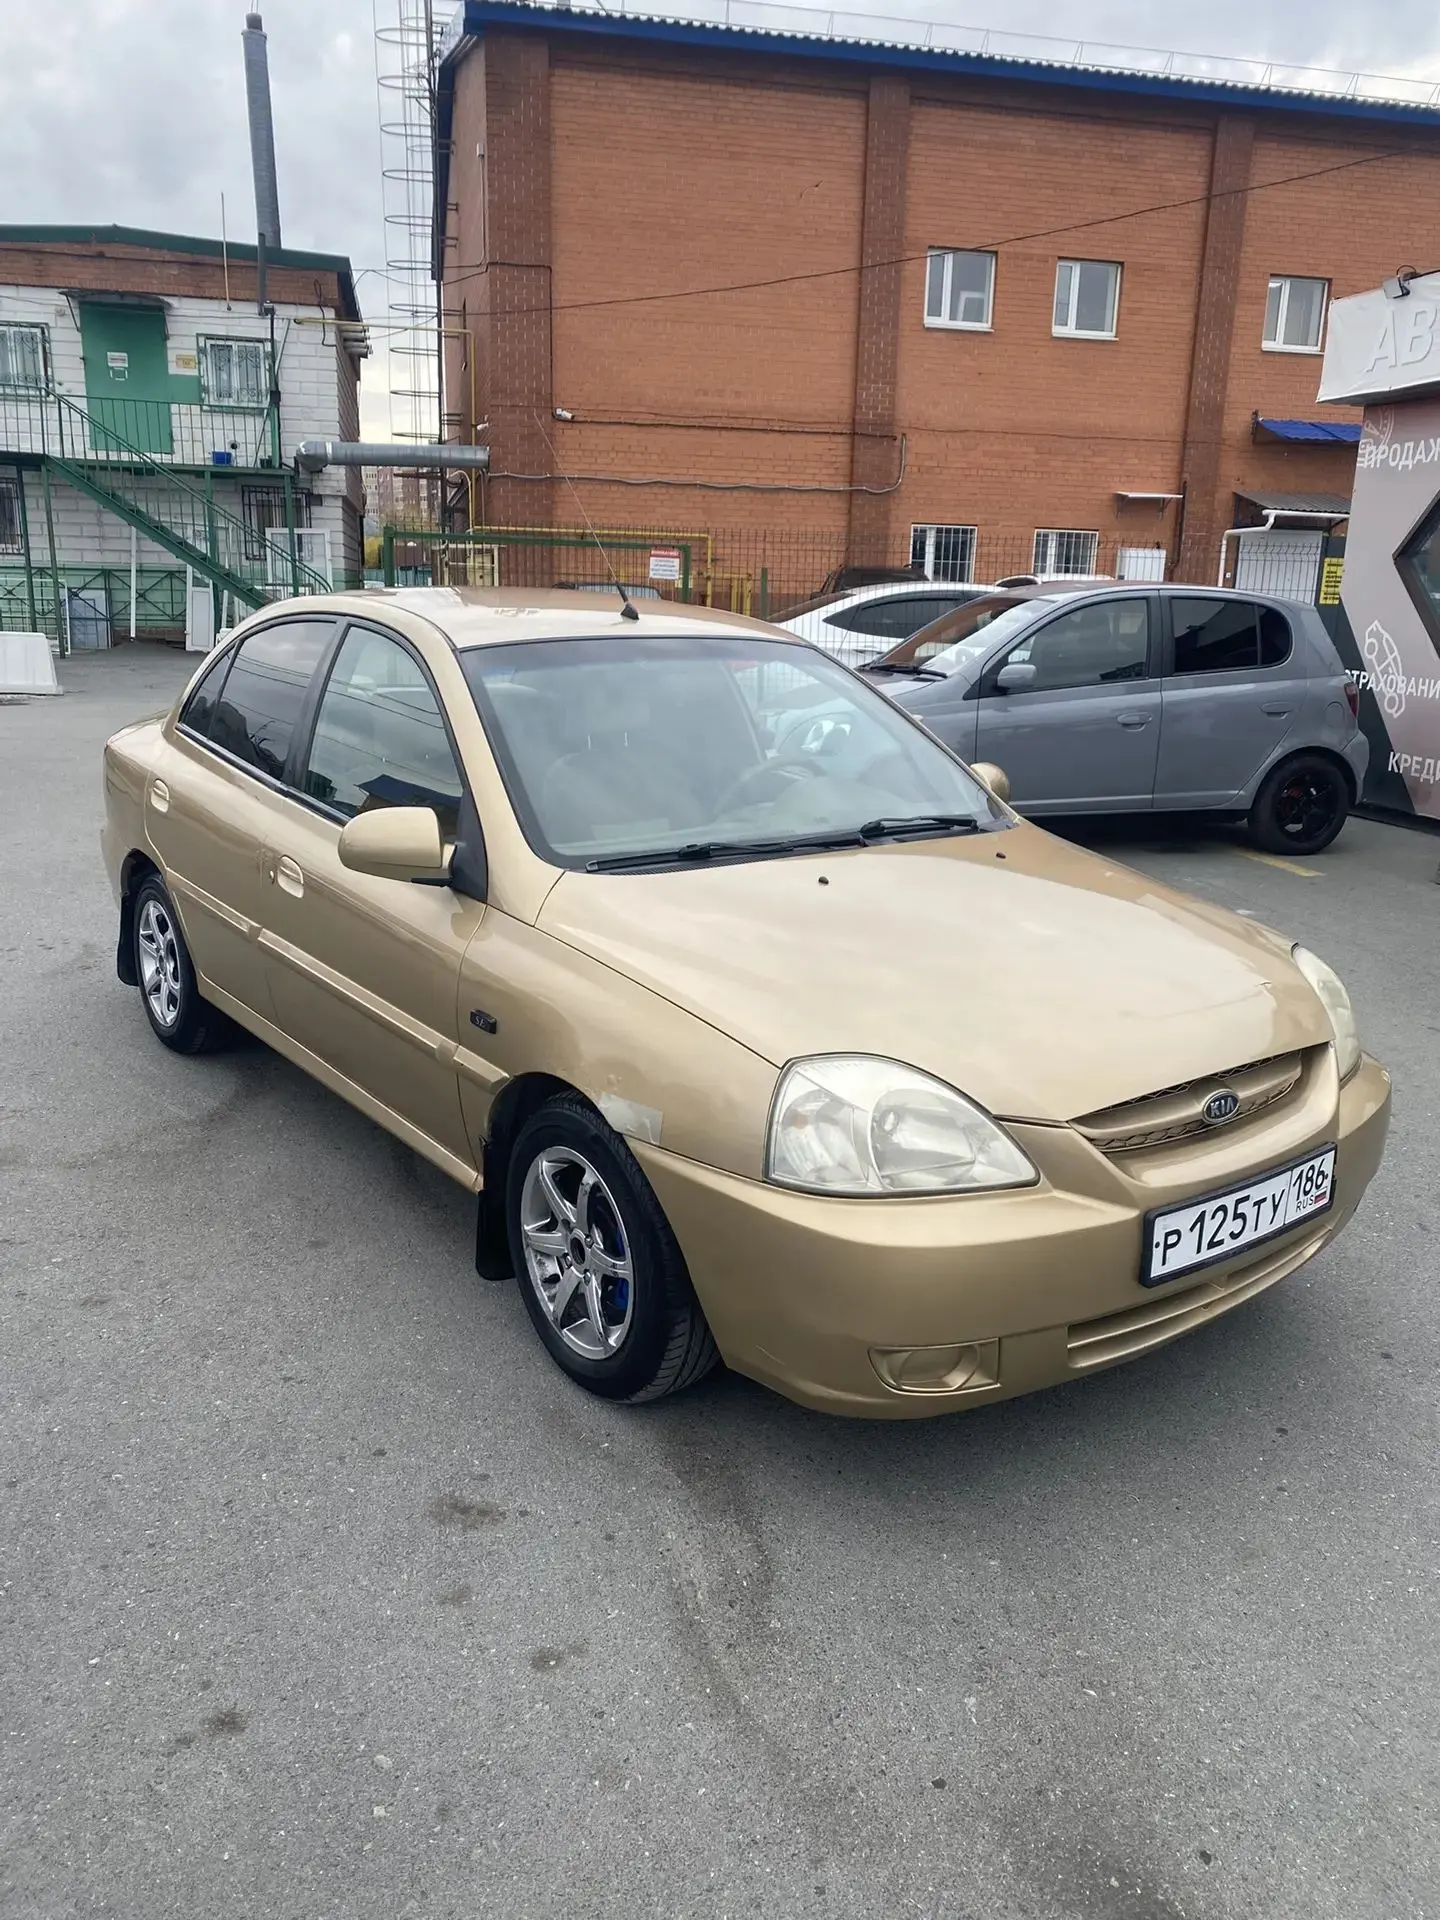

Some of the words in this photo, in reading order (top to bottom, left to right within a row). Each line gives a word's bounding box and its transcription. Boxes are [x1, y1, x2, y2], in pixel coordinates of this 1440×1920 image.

[1210, 1097, 1234, 1117] KIA
[1292, 1158, 1326, 1201] 186
[1295, 1196, 1315, 1213] RUS
